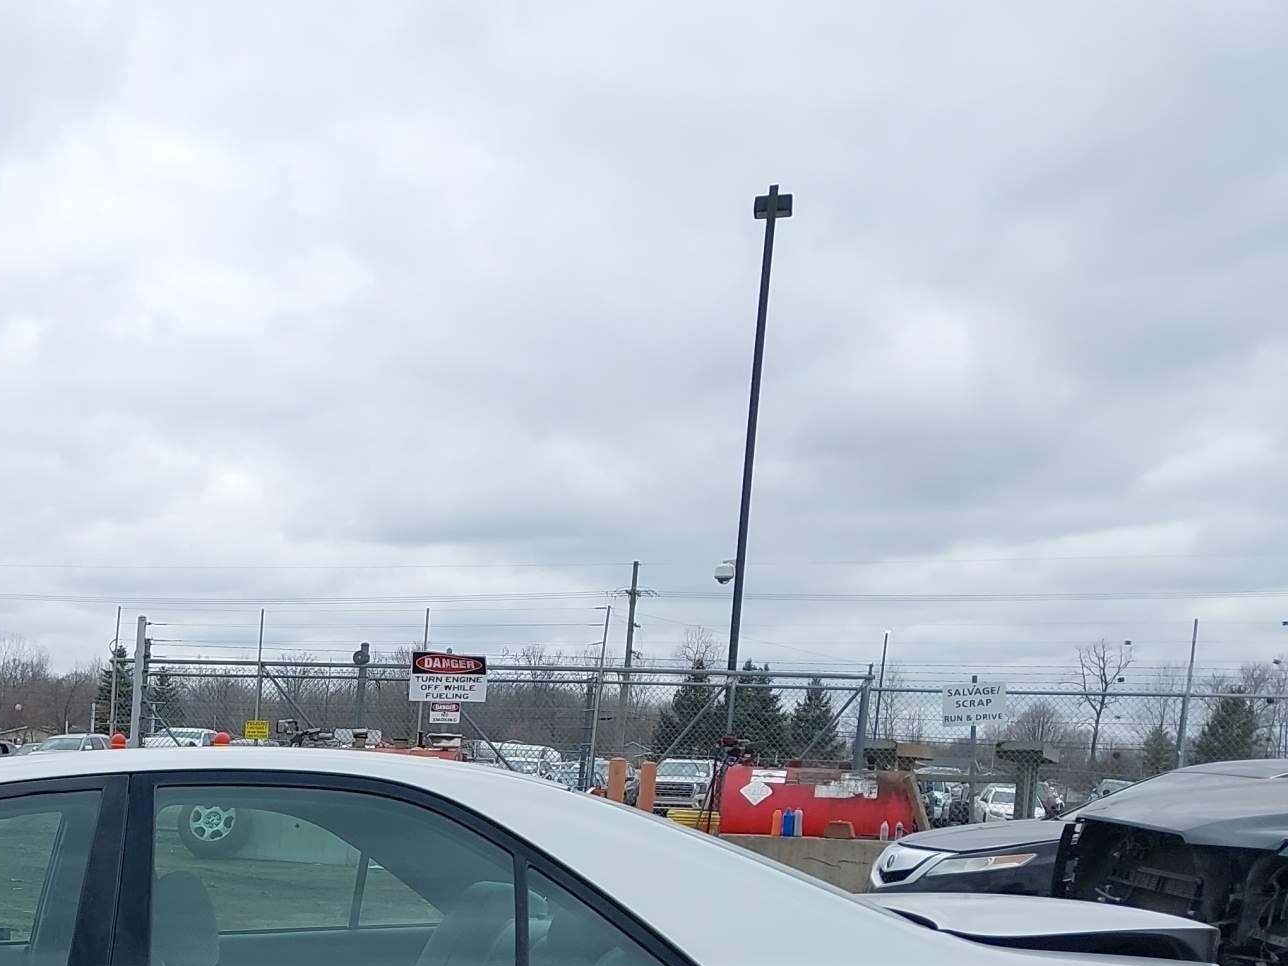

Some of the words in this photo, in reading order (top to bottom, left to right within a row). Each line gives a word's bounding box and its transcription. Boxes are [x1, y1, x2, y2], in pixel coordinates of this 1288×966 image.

[423, 657, 475, 669] DANGER
[444, 684, 476, 692] WHILE
[947, 685, 1001, 697] SALVAGE/
[425, 692, 470, 700] FUELING
[955, 698, 992, 708] SCRAP
[975, 713, 1003, 721] DRIVE
